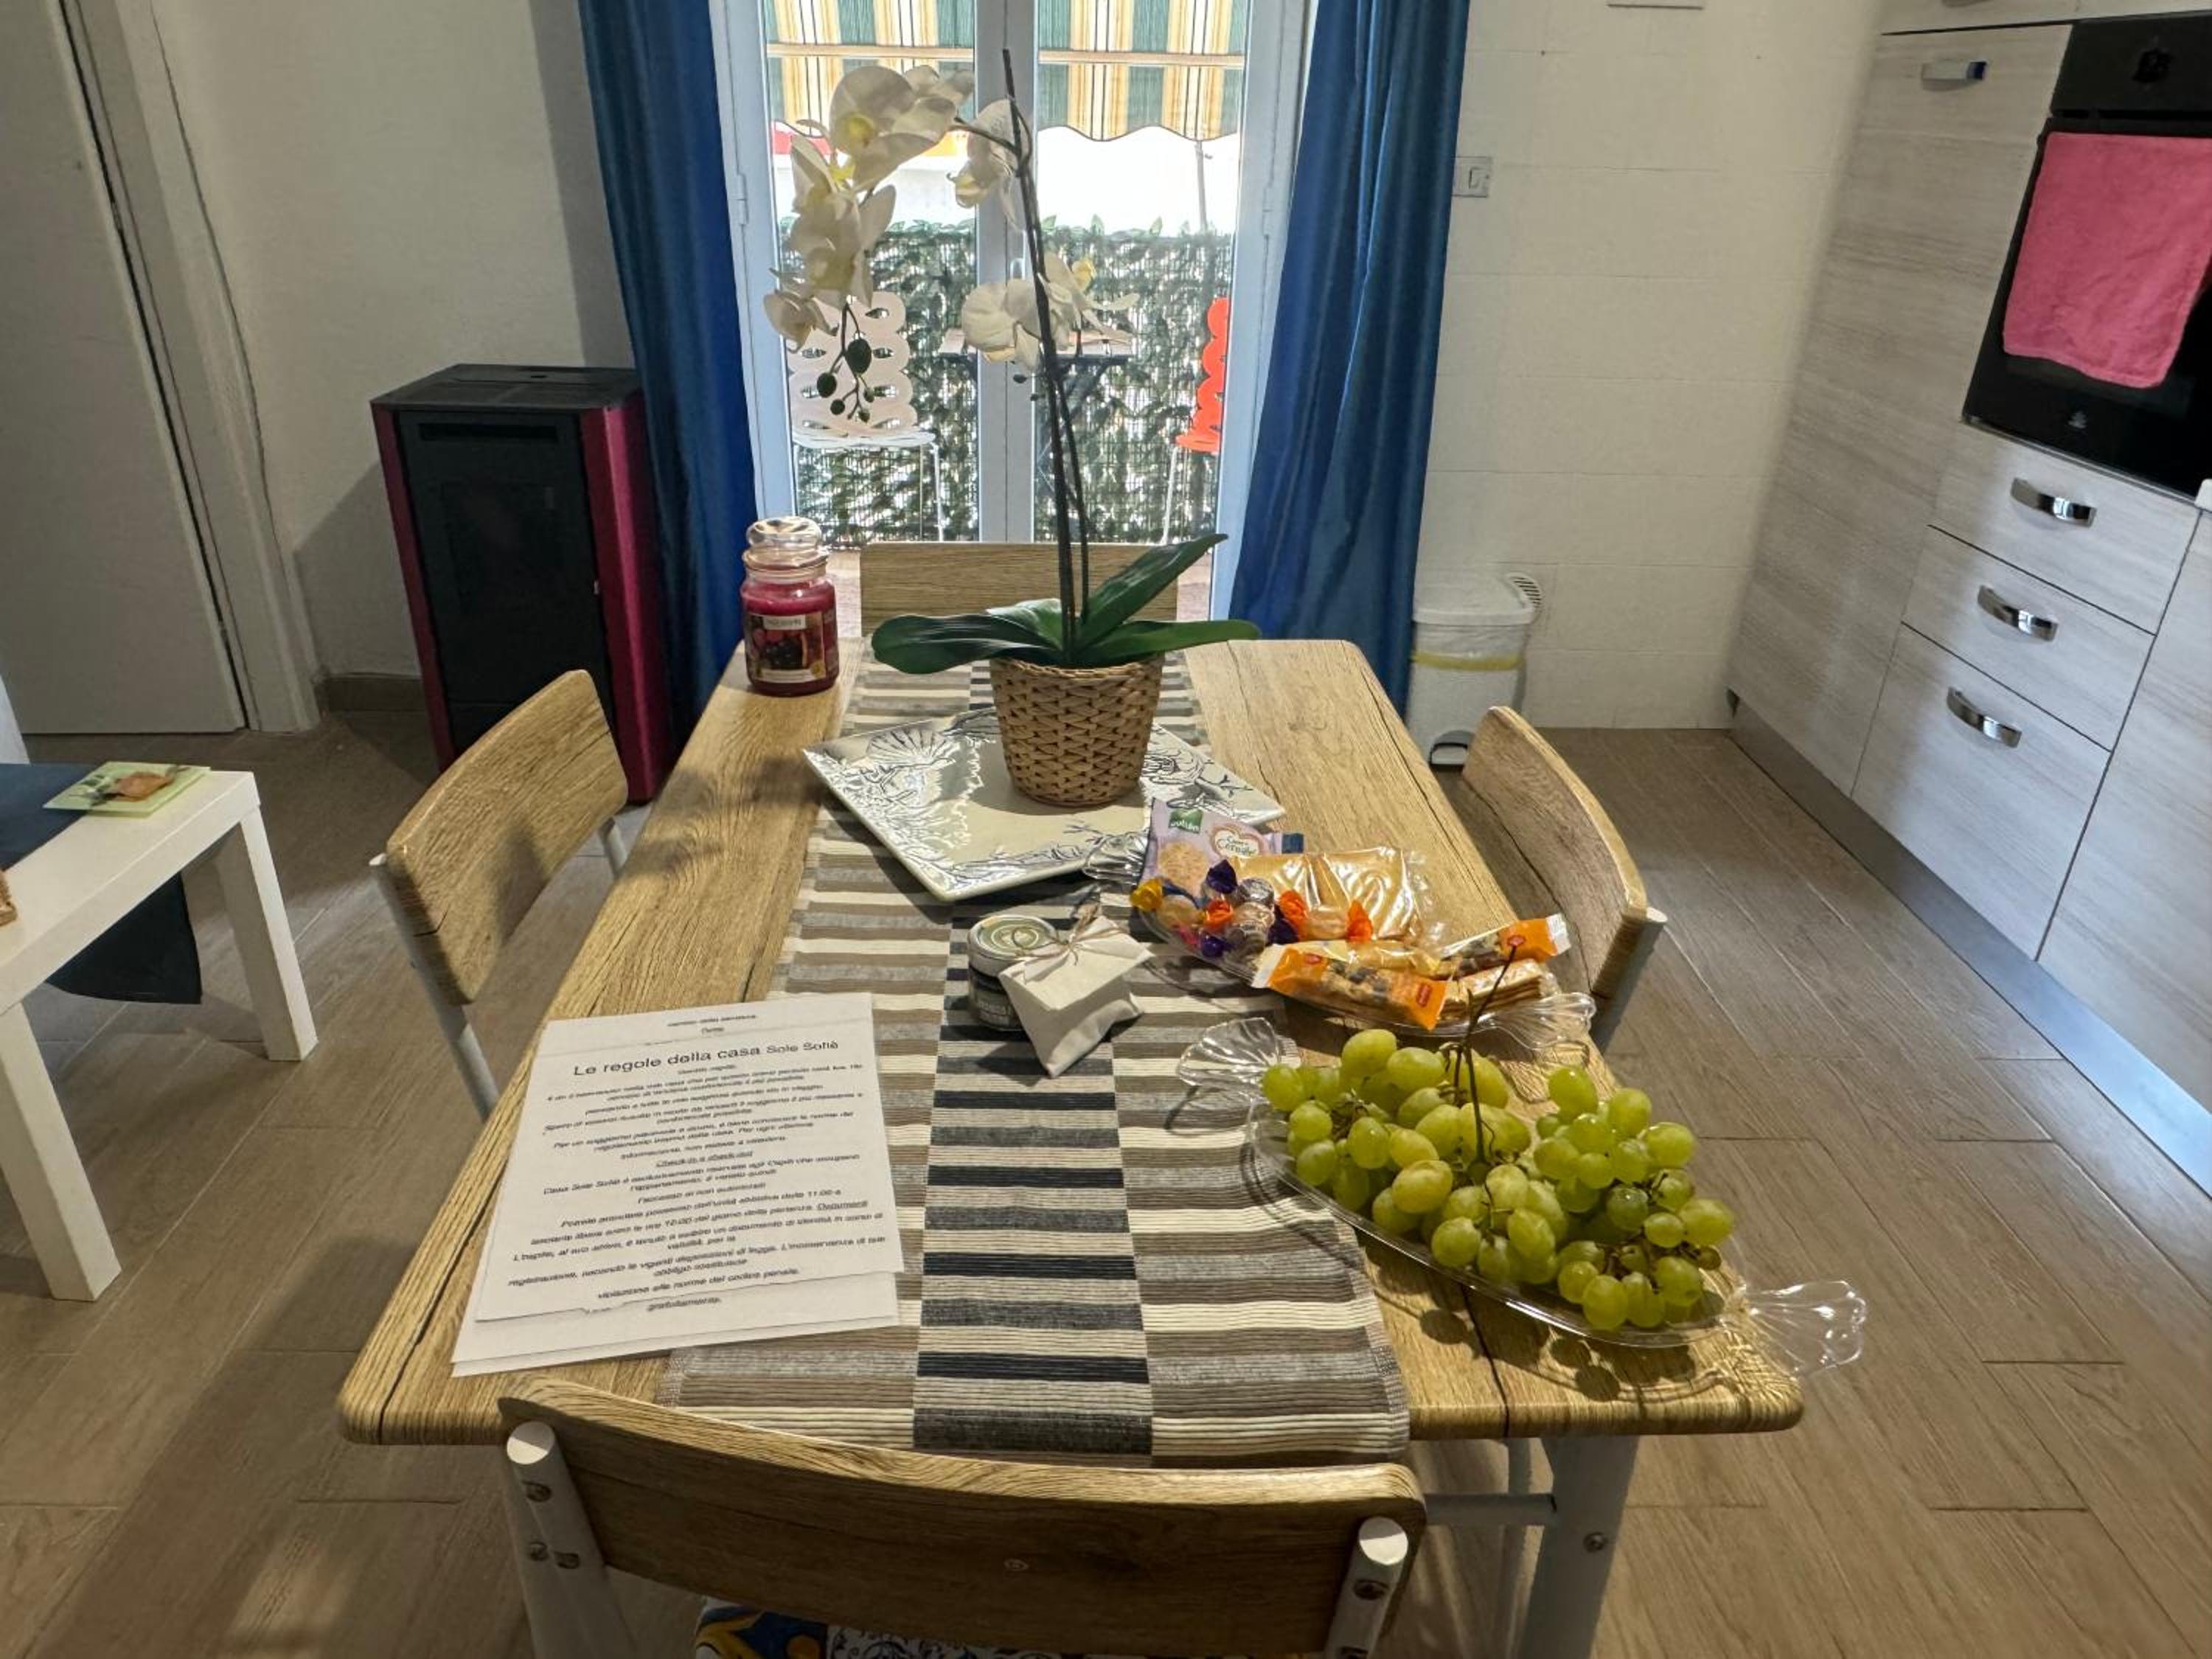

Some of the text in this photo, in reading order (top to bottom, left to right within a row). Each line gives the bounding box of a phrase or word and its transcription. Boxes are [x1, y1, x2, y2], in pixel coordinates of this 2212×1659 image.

[574, 1065, 596, 1075] Le
[603, 1058, 661, 1072] regole
[667, 1051, 712, 1065] della
[718, 1047, 760, 1059] casa
